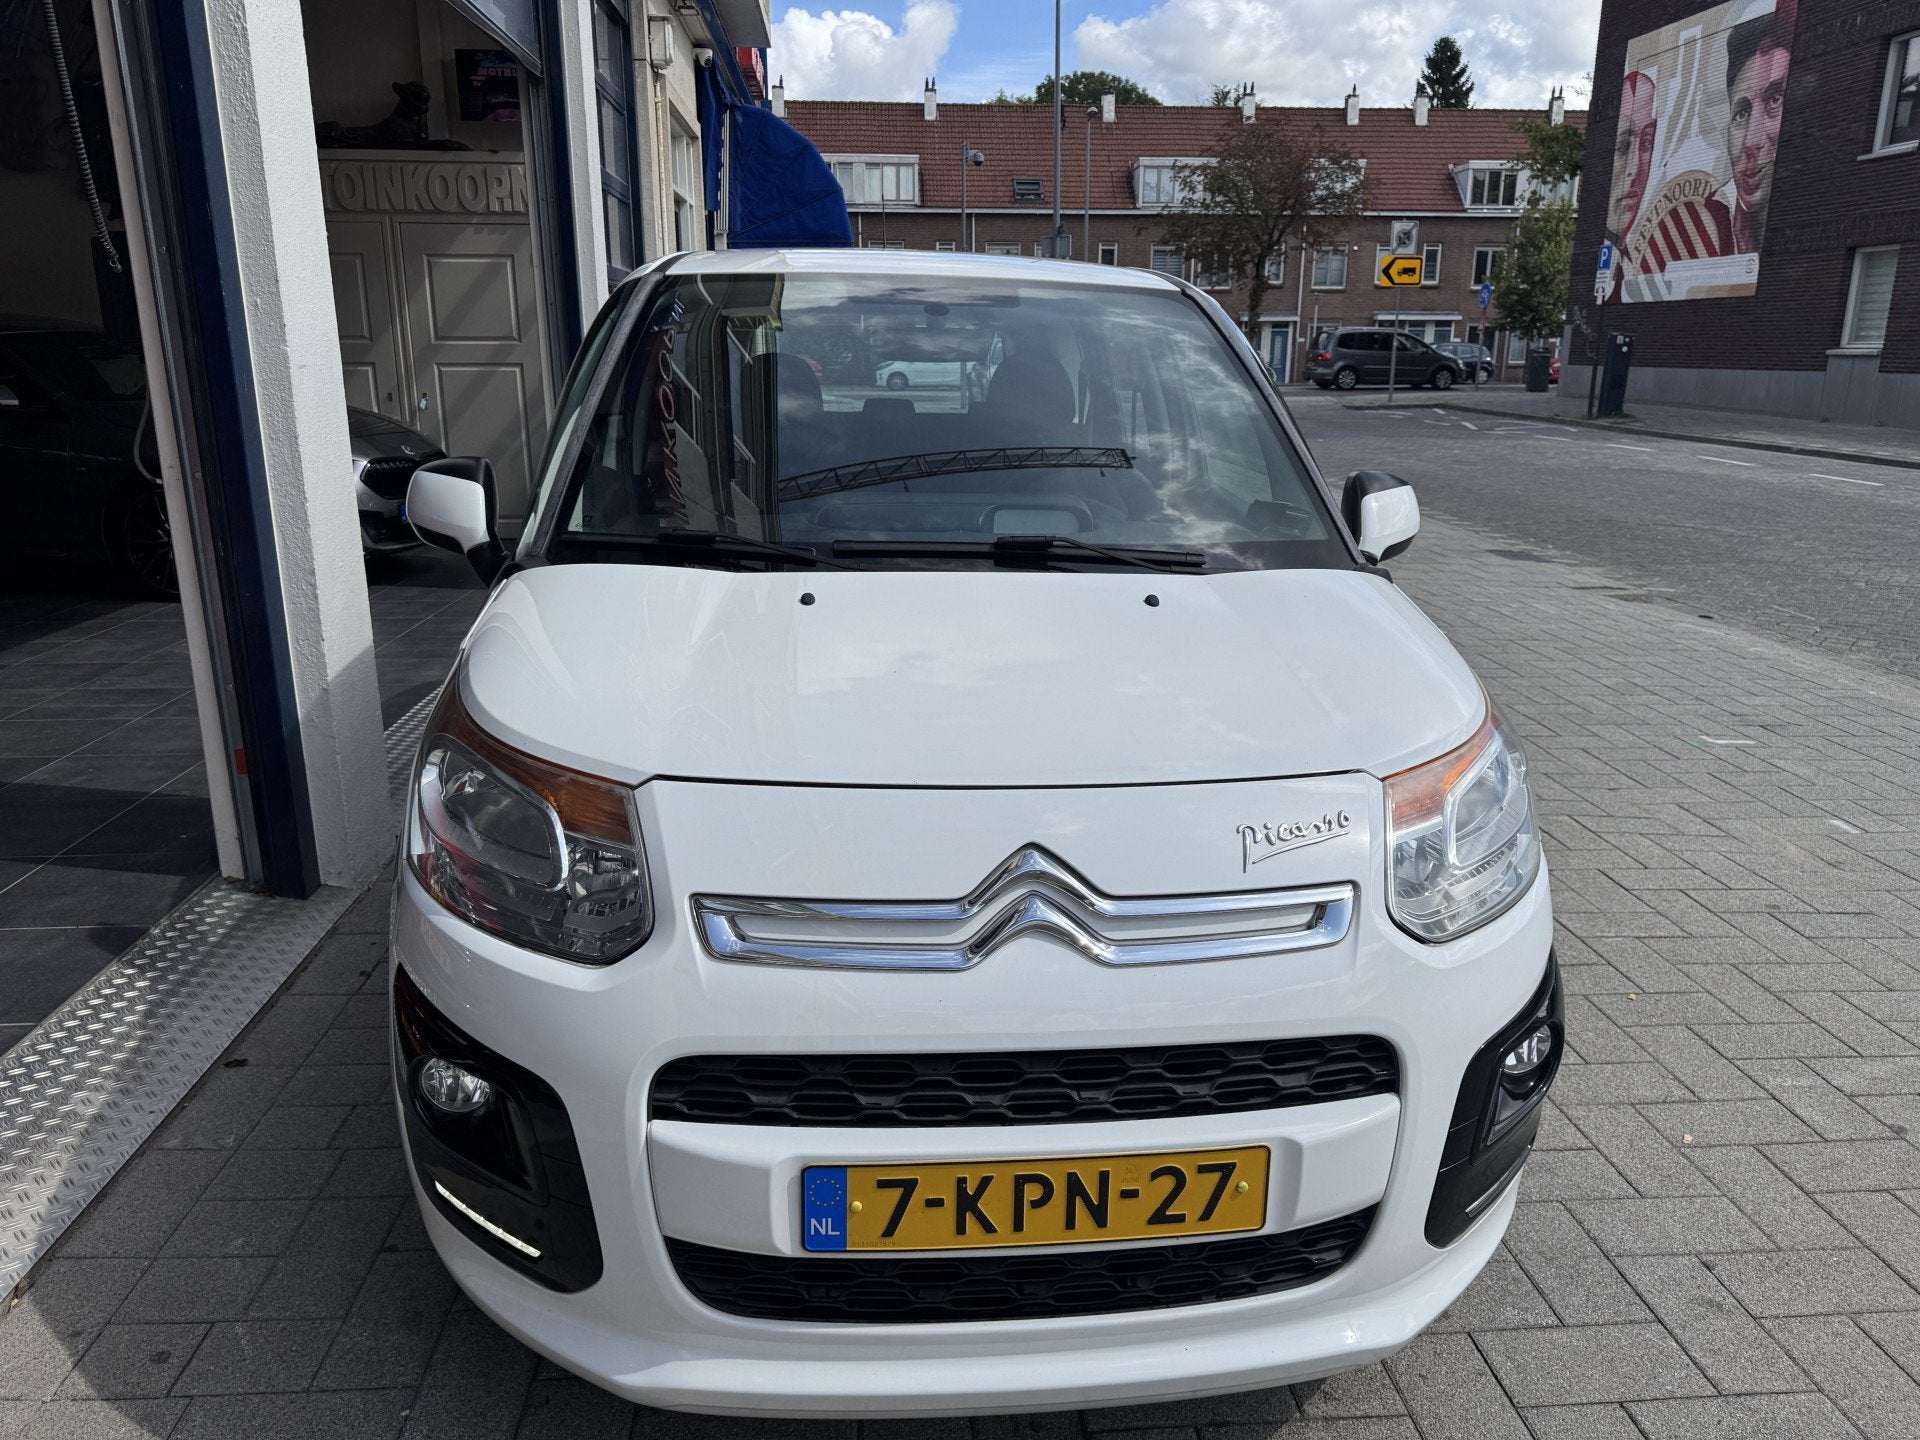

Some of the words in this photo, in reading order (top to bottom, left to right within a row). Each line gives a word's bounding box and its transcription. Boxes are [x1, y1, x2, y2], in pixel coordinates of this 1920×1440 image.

[1600, 248, 1609, 268] P
[1236, 809, 1351, 874] Picasso
[810, 1217, 841, 1236] NL
[876, 1161, 1238, 1237] 7-KPN-27
